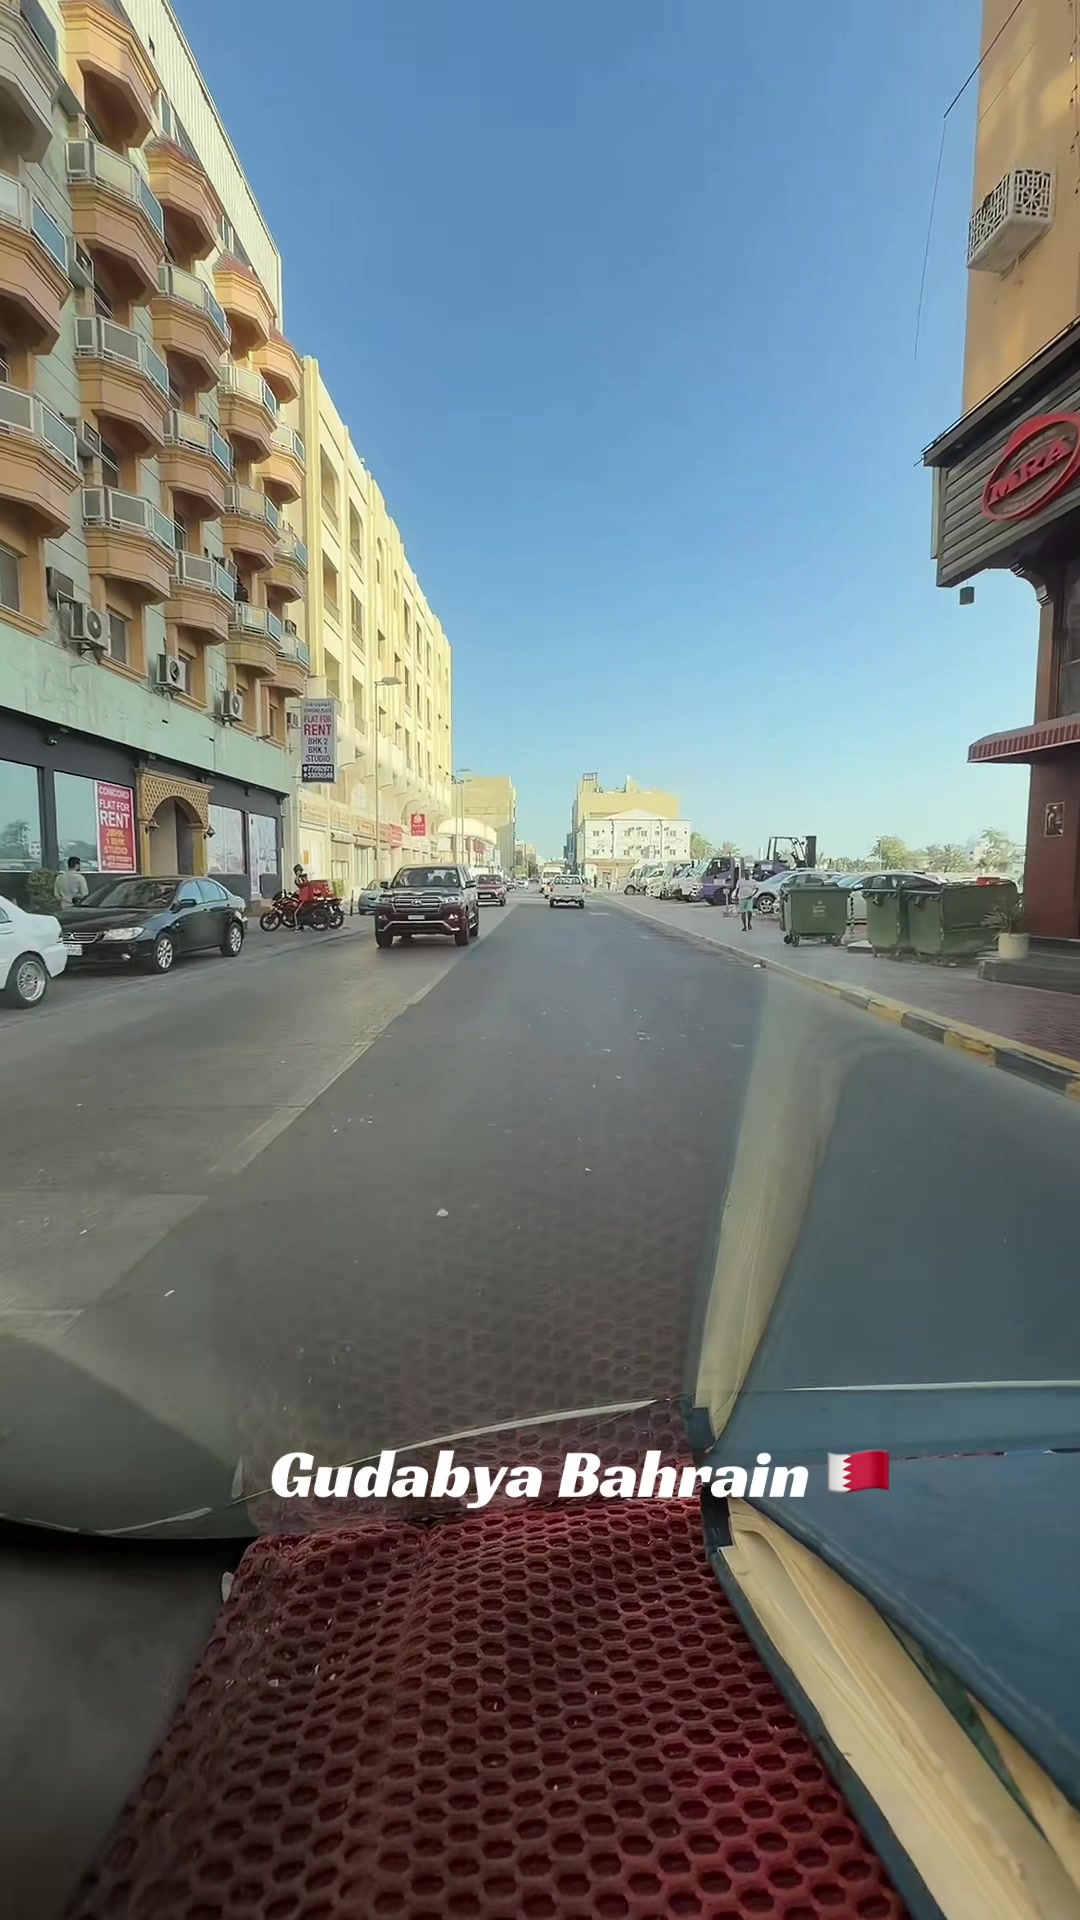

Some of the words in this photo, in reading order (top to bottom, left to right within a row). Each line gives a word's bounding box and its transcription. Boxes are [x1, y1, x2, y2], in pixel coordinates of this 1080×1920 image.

[987, 436, 1074, 506] MRA
[304, 715, 318, 723] FLAT
[320, 715, 332, 723] FOR
[304, 724, 332, 736] RENT
[308, 737, 322, 745] BHK
[308, 746, 322, 754] BHK
[305, 754, 331, 762] STUDIO
[98, 786, 130, 799] CONCORD
[99, 799, 116, 810] FLAT
[116, 801, 130, 812] FOR
[100, 810, 130, 828] RENT
[103, 845, 128, 855] STUDIO
